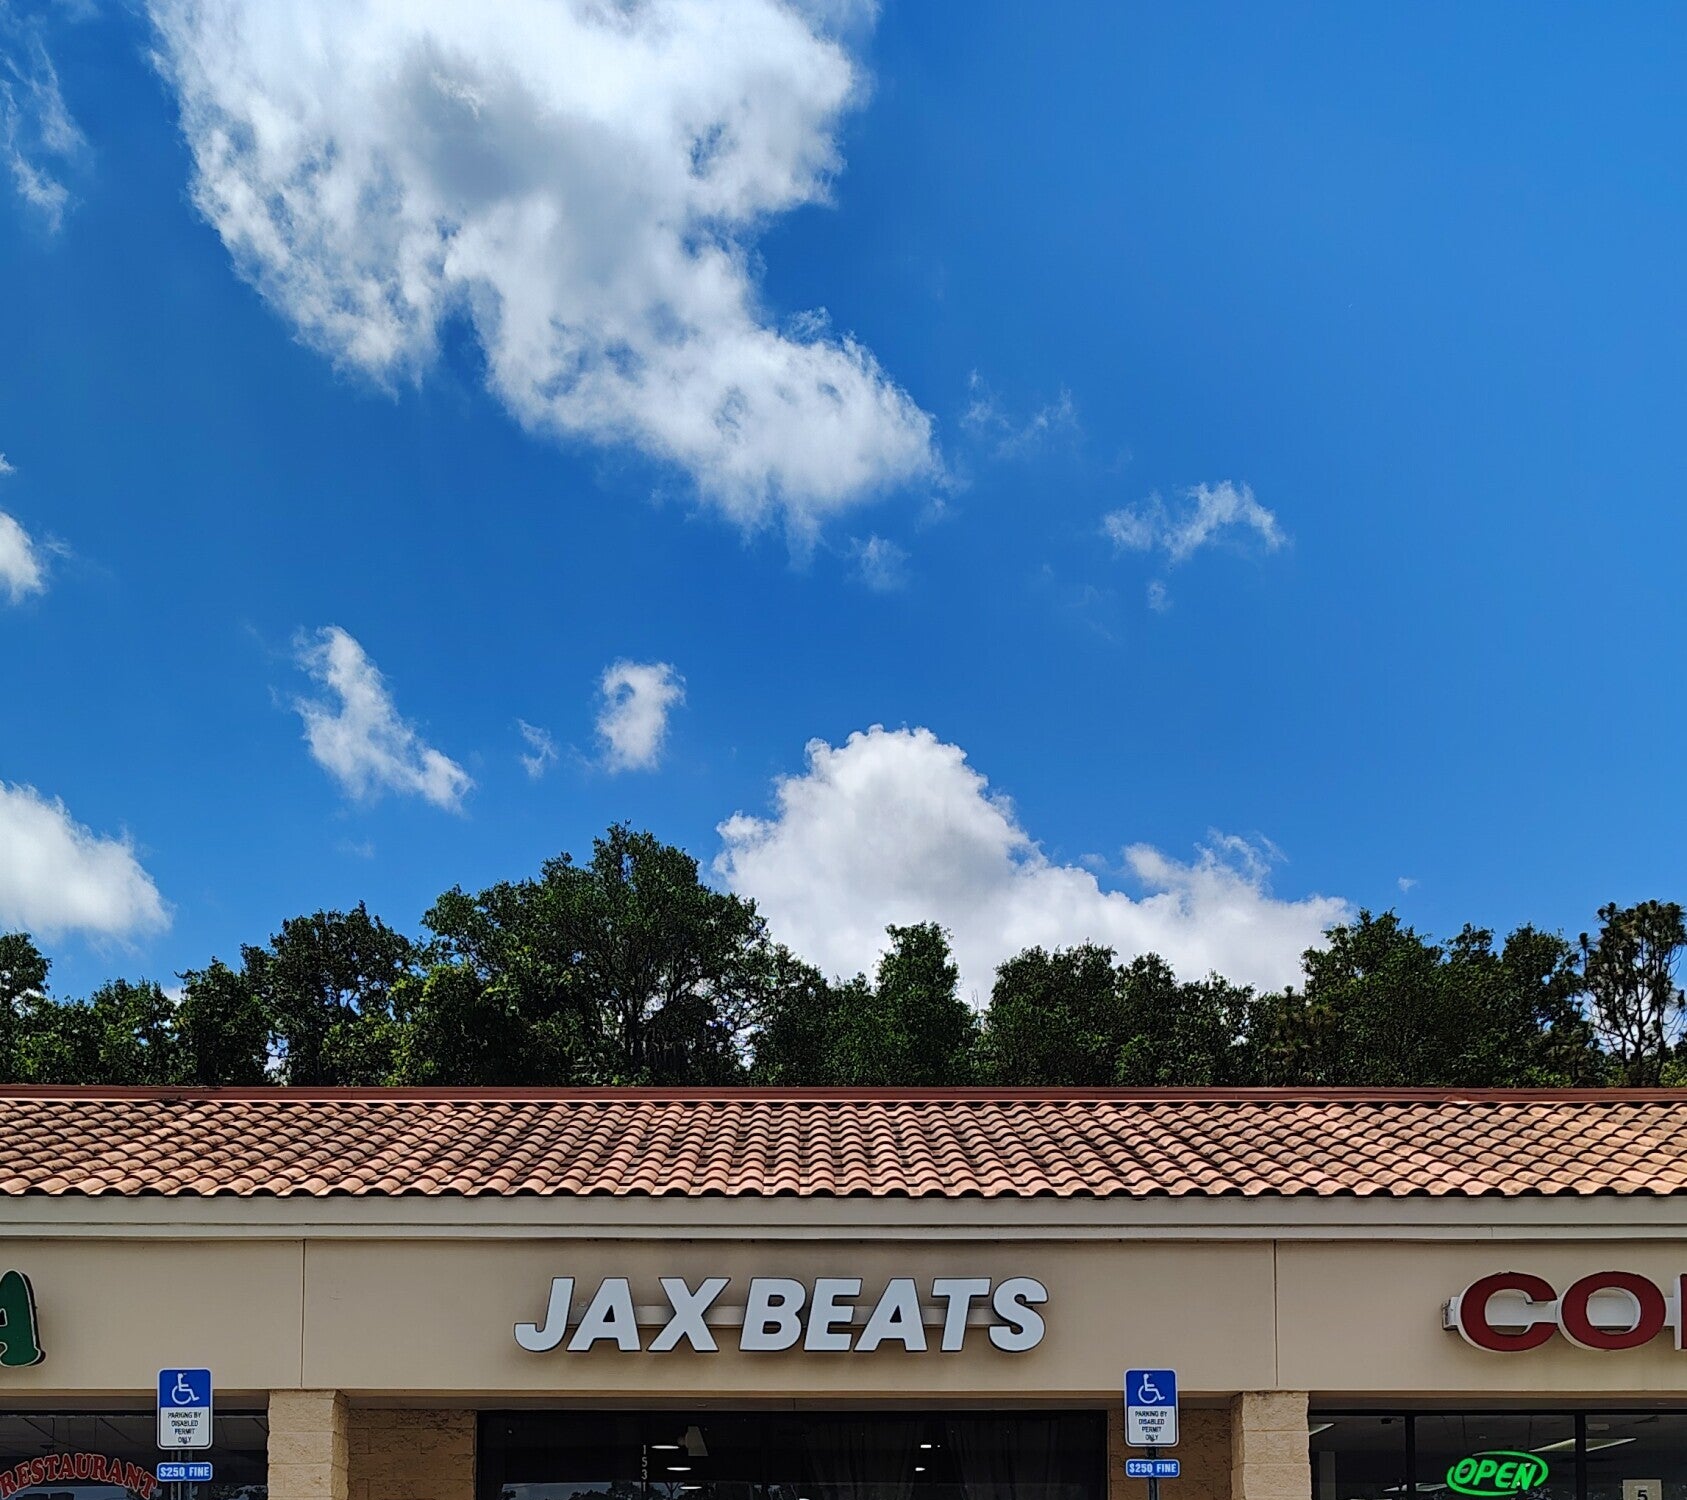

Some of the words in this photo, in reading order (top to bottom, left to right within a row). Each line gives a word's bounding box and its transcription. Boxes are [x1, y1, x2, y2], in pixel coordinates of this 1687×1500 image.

[513, 1276, 731, 1353] JAX
[738, 1276, 1049, 1353] BEATS
[0, 1453, 158, 1500] RESTAURANT
[188, 1466, 210, 1477] FINE
[1129, 1462, 1153, 1473] $250
[1156, 1462, 1177, 1473] FINE
[1453, 1457, 1538, 1490] OPEN
